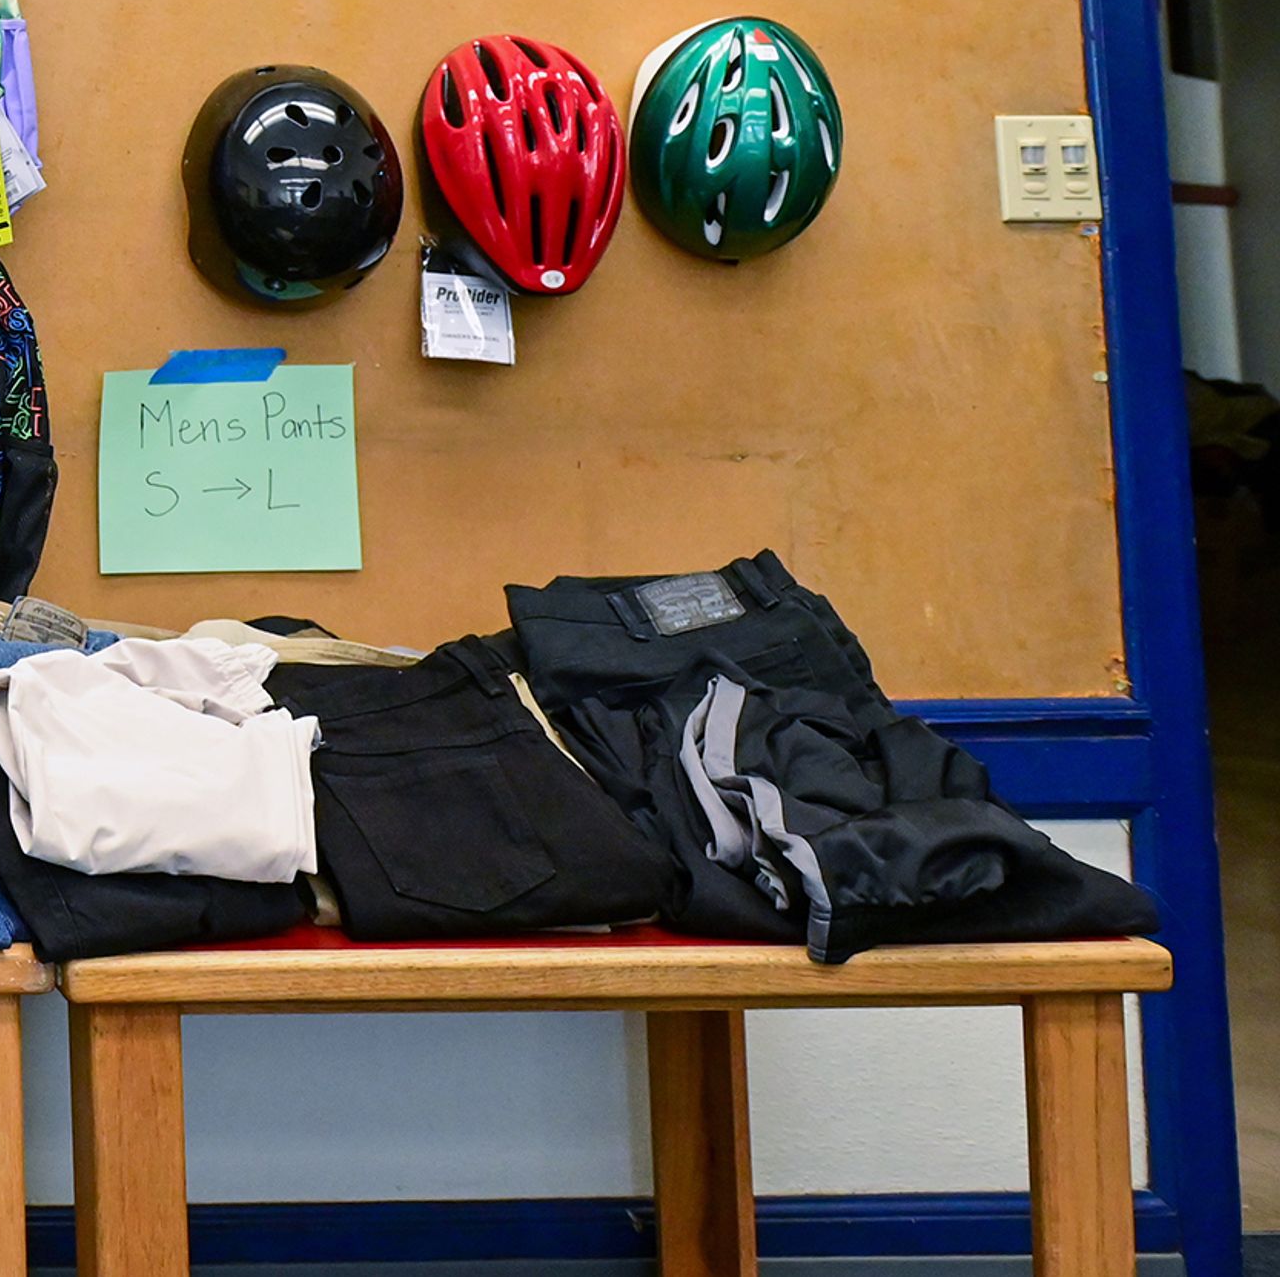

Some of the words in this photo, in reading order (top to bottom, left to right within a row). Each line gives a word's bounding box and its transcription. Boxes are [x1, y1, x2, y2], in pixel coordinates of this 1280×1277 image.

[436, 285, 501, 305] Proider
[139, 399, 247, 450] Mens
[262, 391, 347, 442] Pants
[144, 470, 180, 518] S
[267, 467, 301, 511] L
